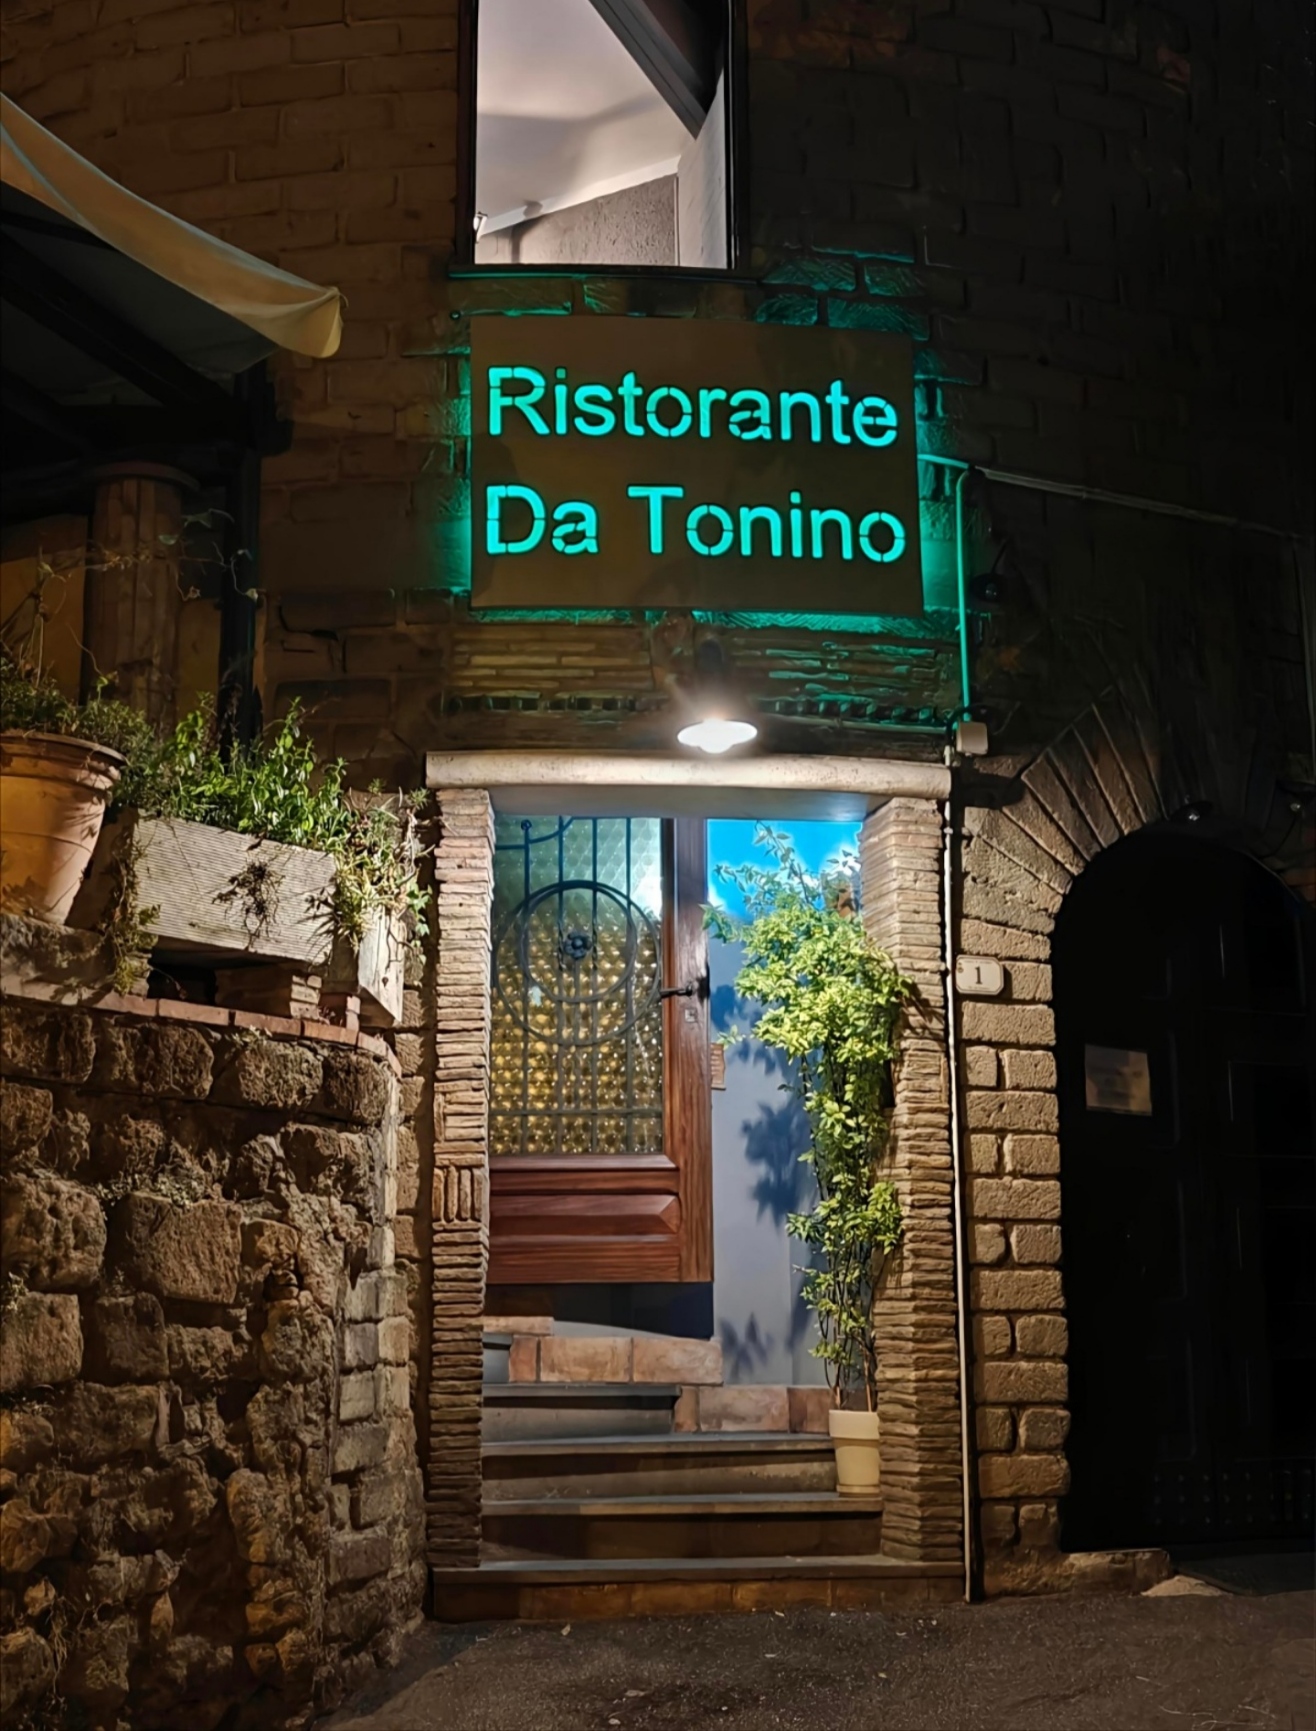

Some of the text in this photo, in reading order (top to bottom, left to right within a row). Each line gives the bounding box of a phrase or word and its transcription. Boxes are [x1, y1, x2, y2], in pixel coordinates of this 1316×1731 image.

[488, 366, 898, 447] Ristorante
[486, 485, 906, 562] Da Tonino
[974, 965, 984, 985] 1
